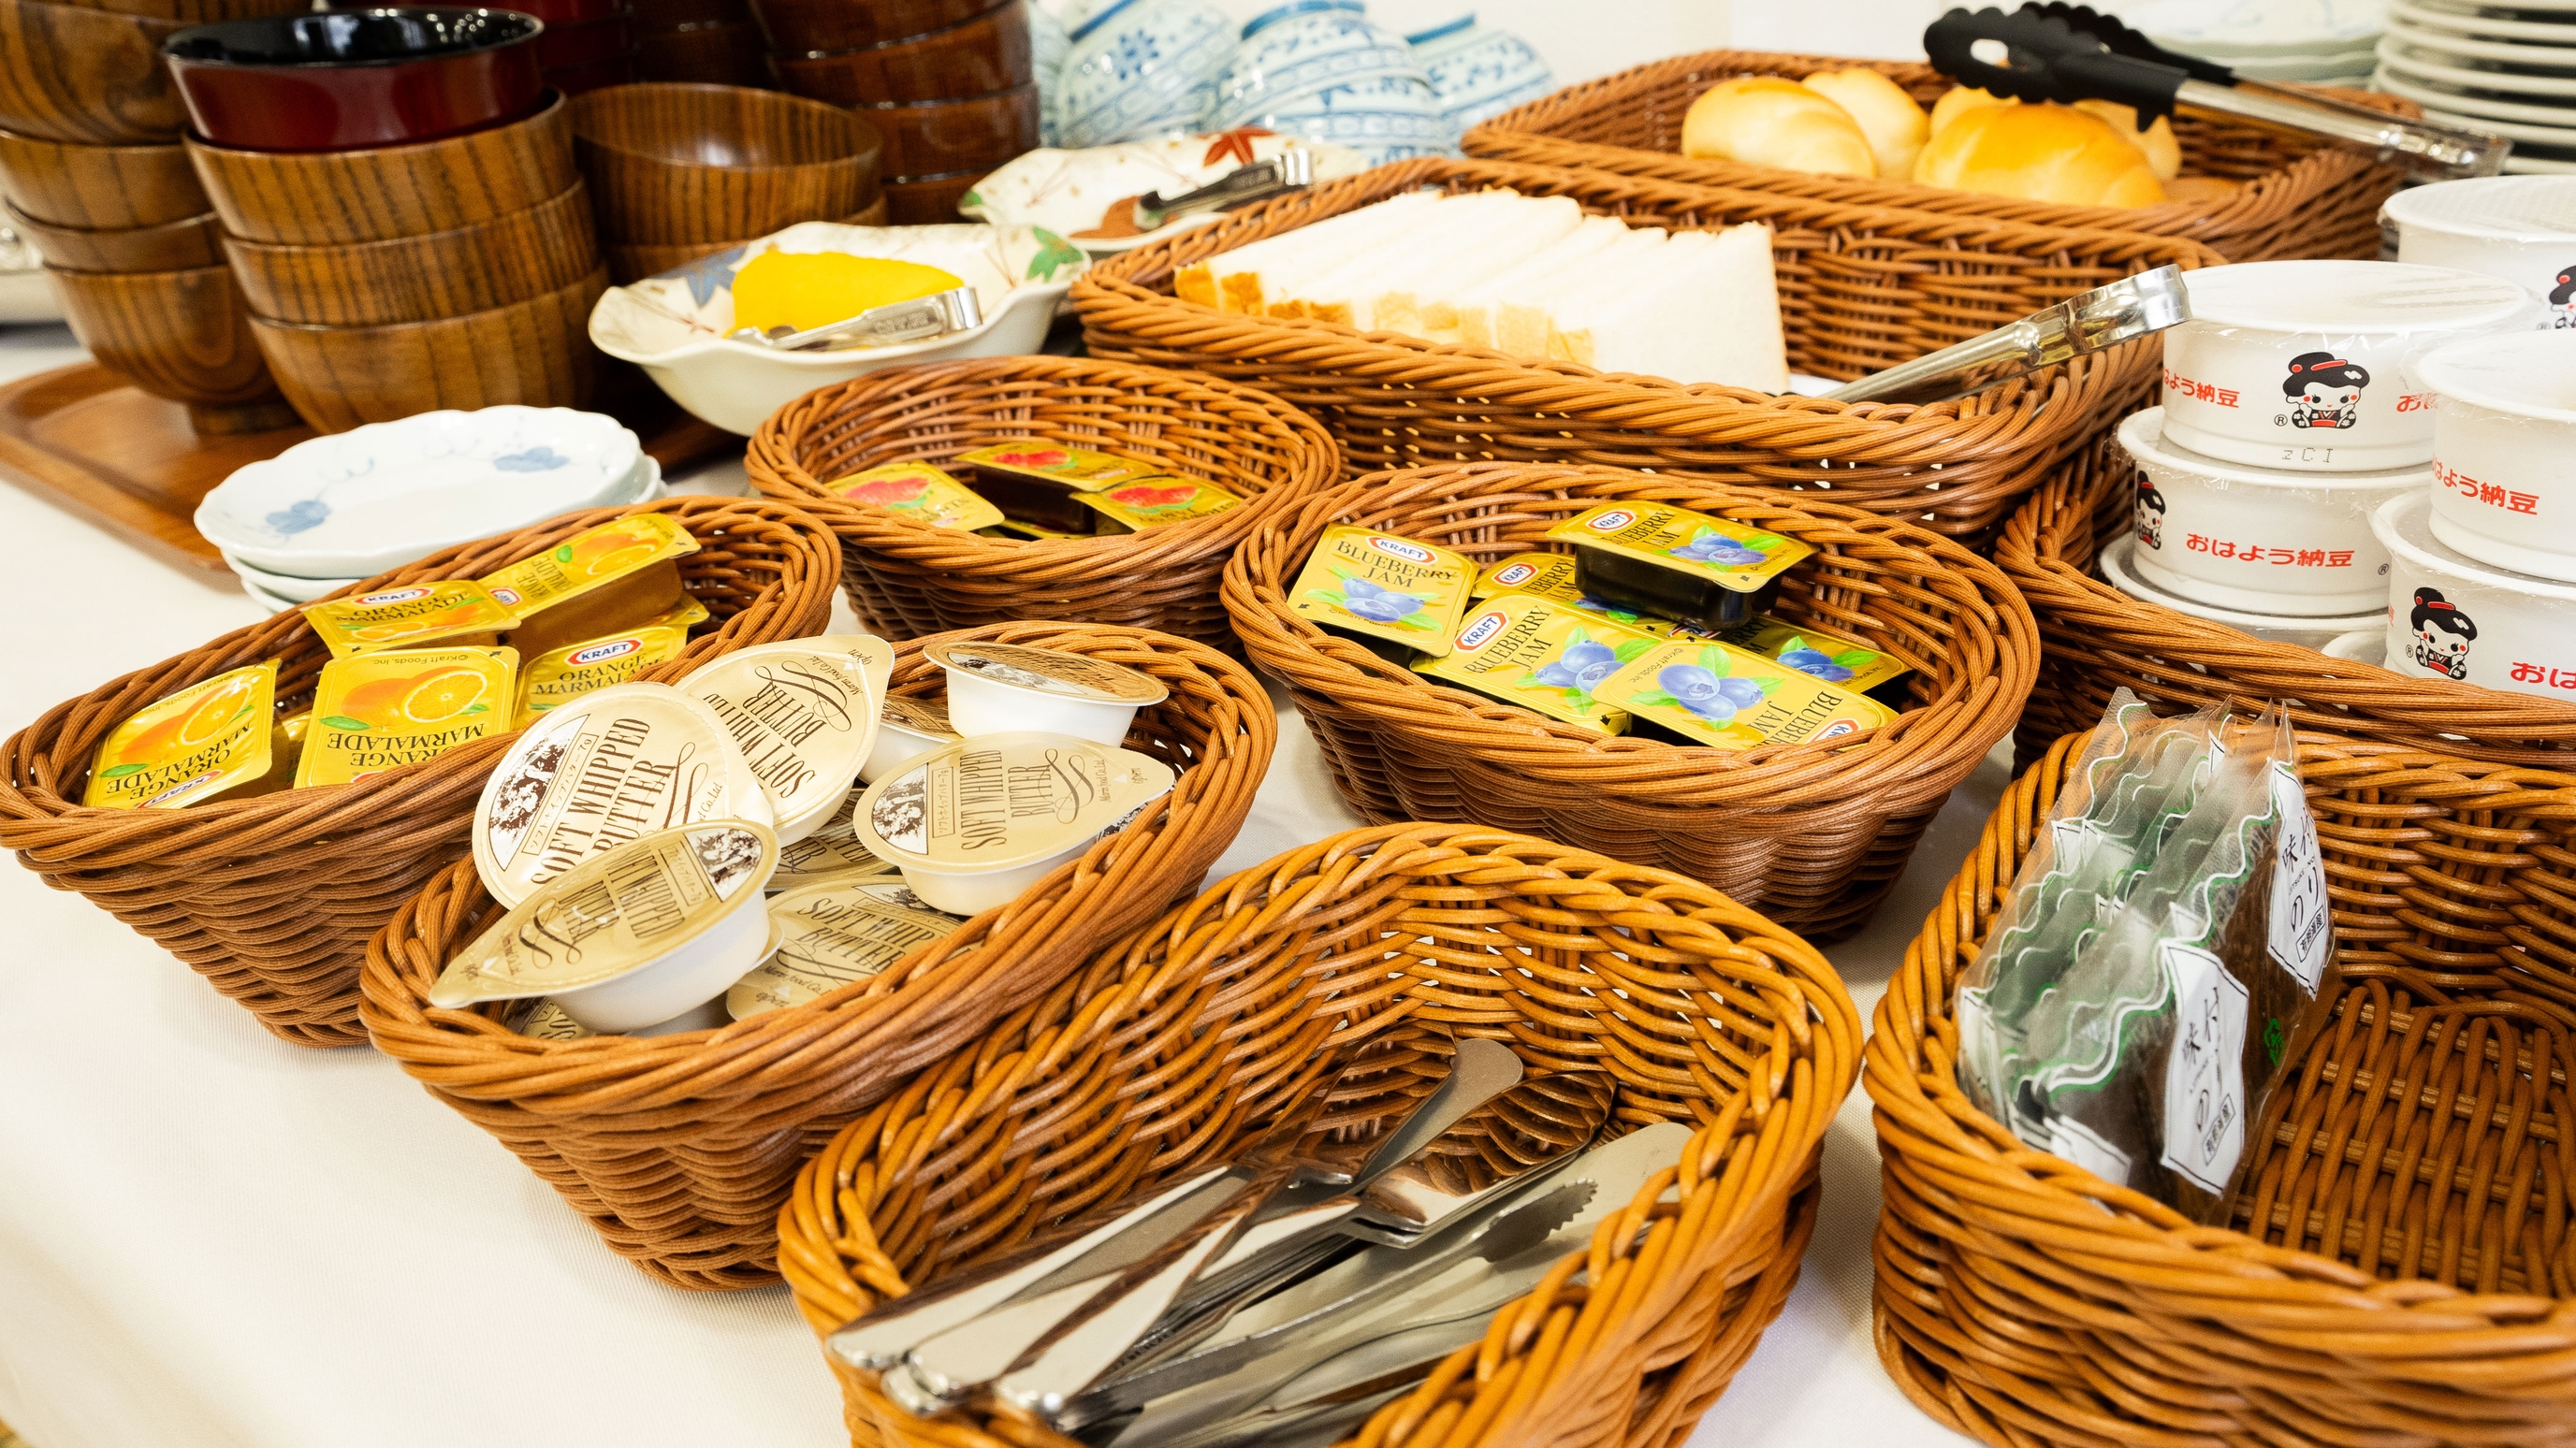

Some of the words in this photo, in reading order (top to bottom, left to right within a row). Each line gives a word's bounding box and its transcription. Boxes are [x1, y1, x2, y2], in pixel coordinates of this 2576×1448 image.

[2433, 456, 2540, 515] はよう納豆
[1596, 514, 1627, 529] KRAFT
[1379, 541, 1426, 558] KRAFT
[1642, 530, 1681, 549] JAM
[2186, 533, 2355, 568] おはよう納豆
[1336, 541, 1458, 581] BLUEBERRY
[1362, 567, 1413, 588] JAM
[1503, 566, 1529, 582] KRAFT
[1519, 560, 1576, 595] UEBERRY
[335, 591, 470, 622] MARMALADE
[353, 594, 445, 616] ORANGE
[367, 591, 417, 602] KRAFT
[1546, 581, 1578, 601] JAM
[1463, 616, 1498, 645] KRAFT
[1463, 605, 1552, 673] BLUEBERRY
[559, 653, 648, 683] ORANGE
[580, 643, 630, 660] KRAFT
[1508, 636, 1554, 671] JAM
[742, 682, 827, 748] BUTTER
[1747, 700, 1794, 735] JAM
[327, 723, 486, 751] MARMALADE
[106, 720, 251, 795] MARMALADE
[129, 747, 232, 801] ORANGE
[749, 742, 817, 799] SOFT
[150, 776, 206, 804] KRAFT
[960, 749, 1004, 805] WHIPPED
[1008, 762, 1056, 818] BUTTER
[531, 820, 594, 885] SOFT
[567, 717, 650, 816] WHIPPED
[961, 807, 1008, 850] SOFT
[559, 880, 619, 945] BUTTER
[616, 869, 685, 939] WHIPPED
[797, 897, 877, 932] SOFT
[795, 926, 910, 973] BUTTER
